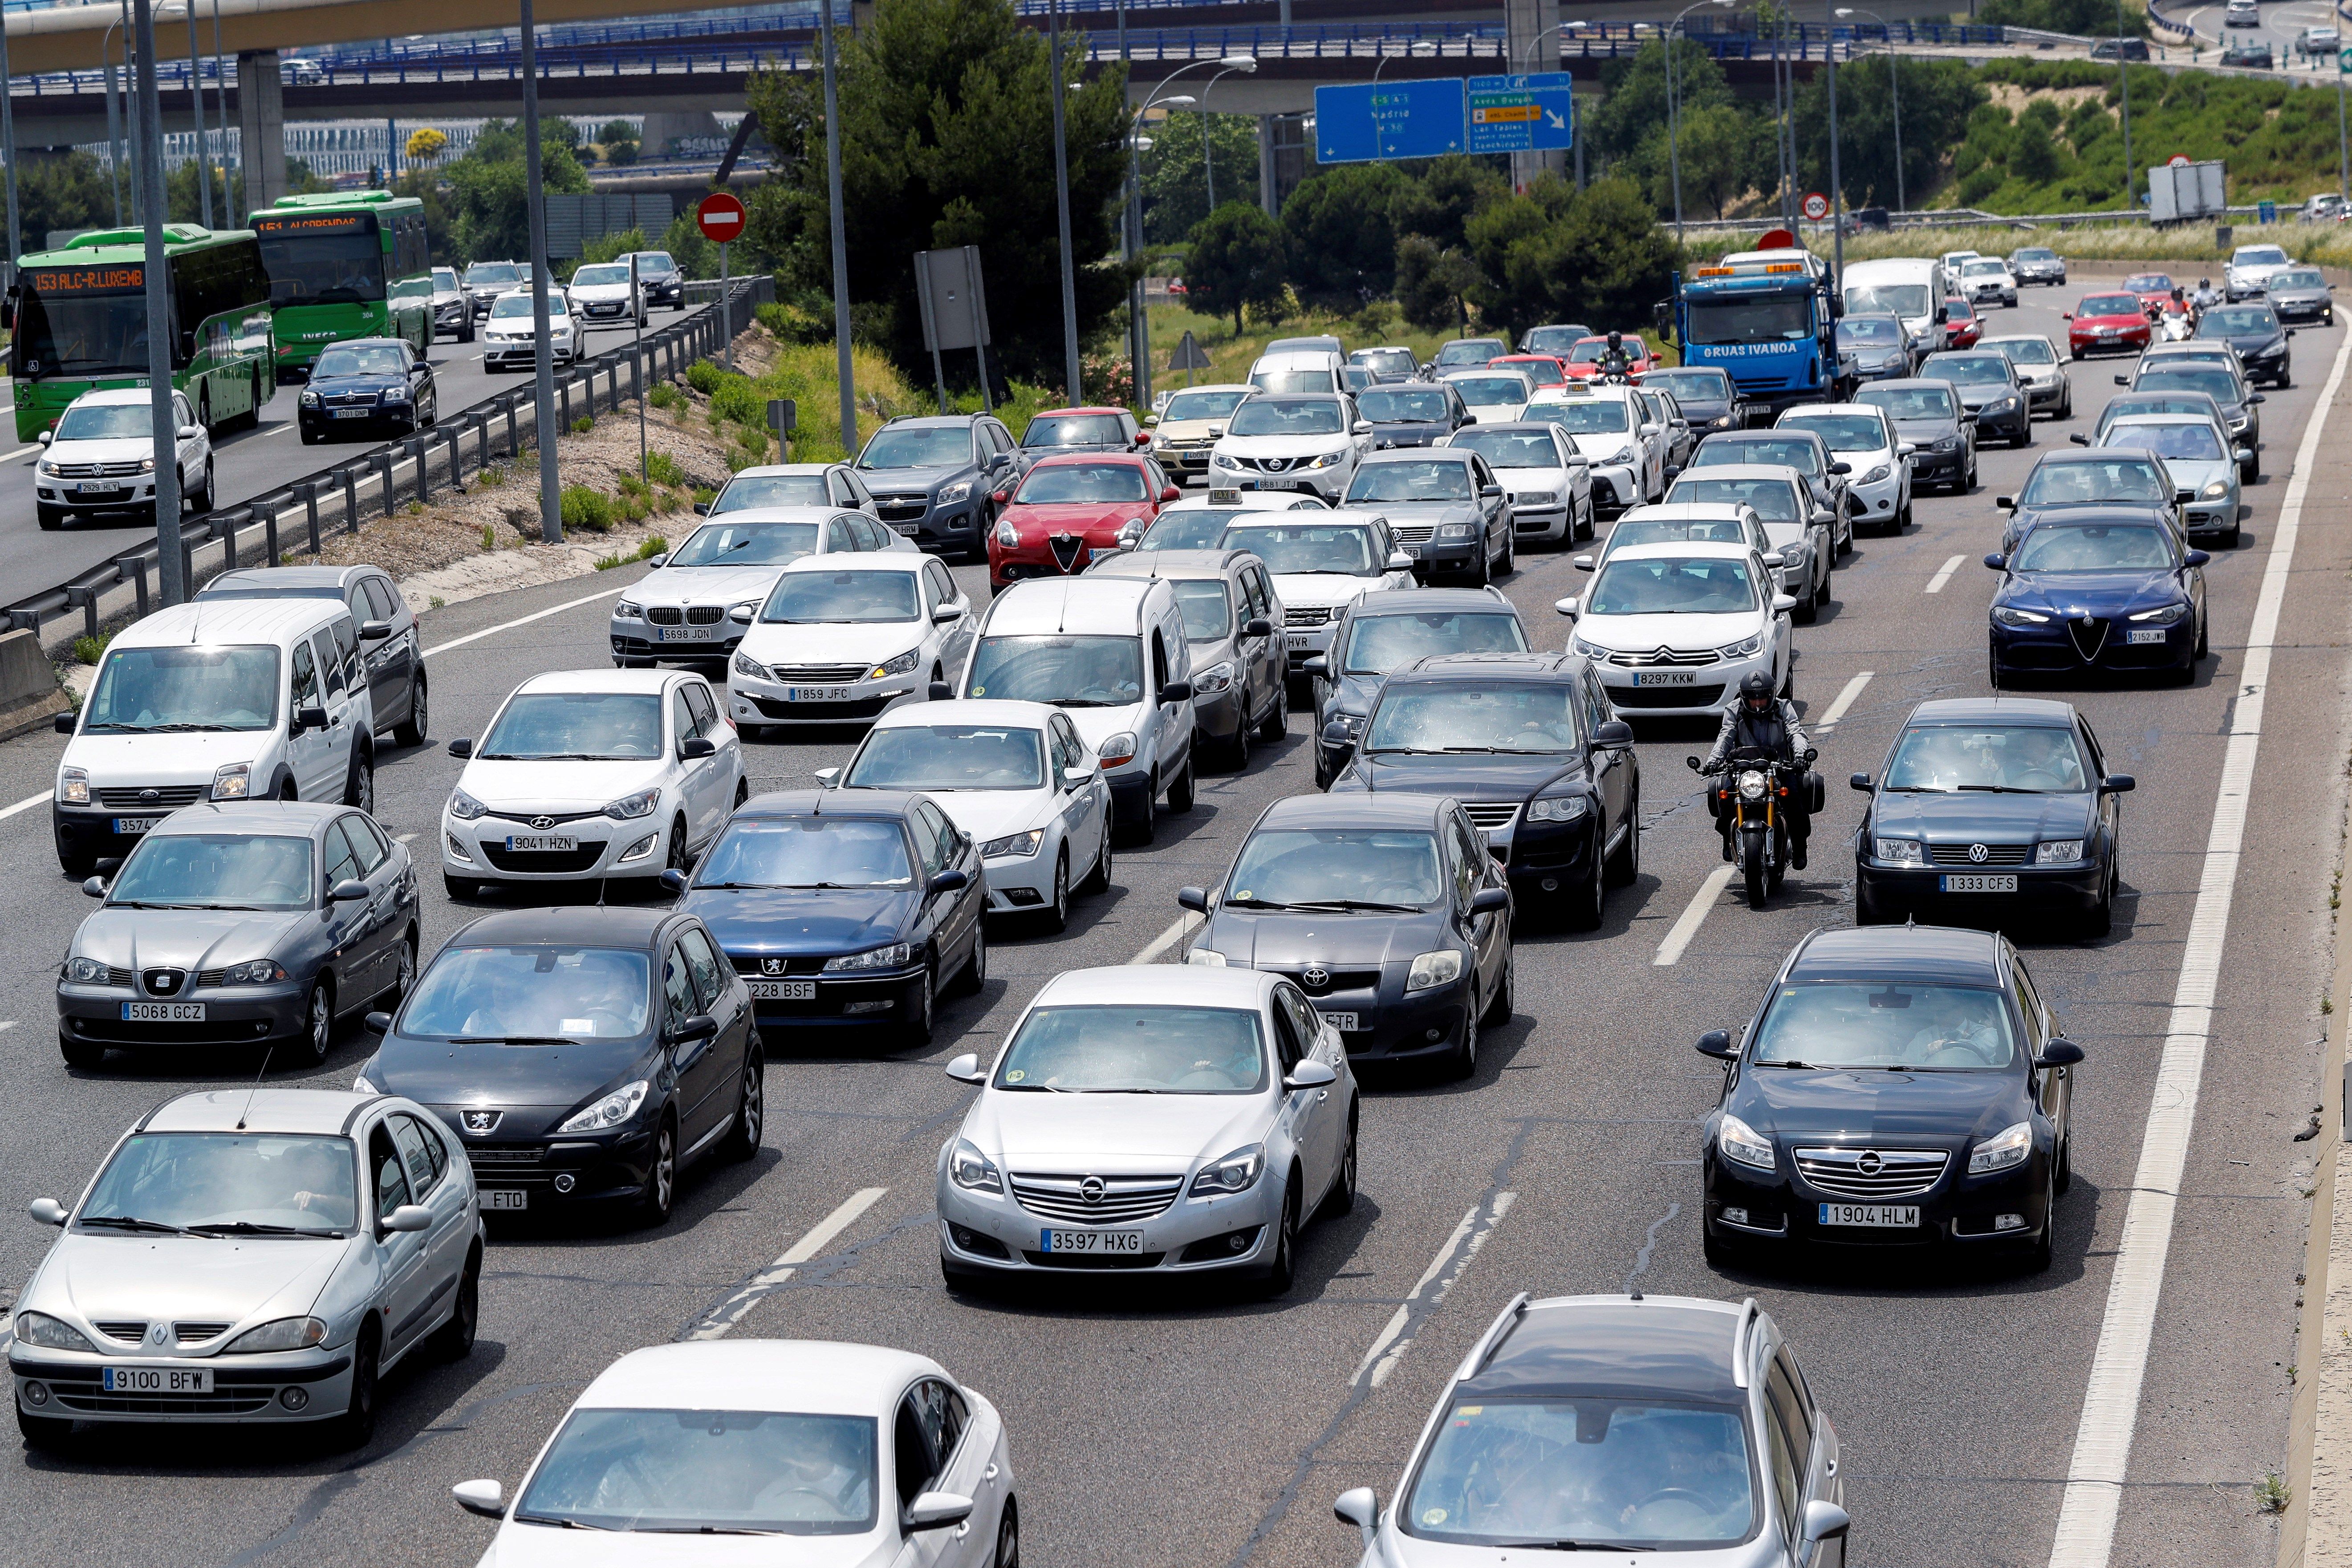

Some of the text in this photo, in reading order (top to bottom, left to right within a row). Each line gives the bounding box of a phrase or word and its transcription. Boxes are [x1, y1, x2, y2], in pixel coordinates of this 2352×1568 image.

[1371, 110, 1409, 119] Madrid
[1808, 202, 1824, 211] 100
[37, 275, 56, 291] 153
[303, 332, 337, 340] IVECO
[1703, 342, 1797, 357] GRUAS IVANOA
[338, 409, 367, 418] 3701 DNP
[83, 483, 117, 492] 2929 HLY
[902, 525, 916, 533] HRM
[665, 629, 709, 639] 5698 JDN
[2133, 632, 2165, 641] 2152 JWR
[1288, 637, 1308, 647] HVR
[1641, 674, 1693, 684] 8297 KKM
[797, 689, 847, 699] 1859 JFC
[121, 820, 150, 832] 3574
[515, 837, 543, 849] 9041
[549, 837, 571, 849] HZN
[1950, 877, 1983, 890] 1333
[1988, 877, 2014, 890] CFS
[747, 983, 811, 997] 228 BSF
[132, 1006, 168, 1019] 5068
[174, 1005, 201, 1019] GCZ
[494, 1192, 522, 1208] FTD
[1834, 1206, 1876, 1223] 1904
[1882, 1207, 1915, 1224] HLM
[1053, 1234, 1097, 1250] 3597
[1105, 1234, 1138, 1250] HXG
[117, 1371, 160, 1389] 9100
[170, 1372, 203, 1389] BFW
